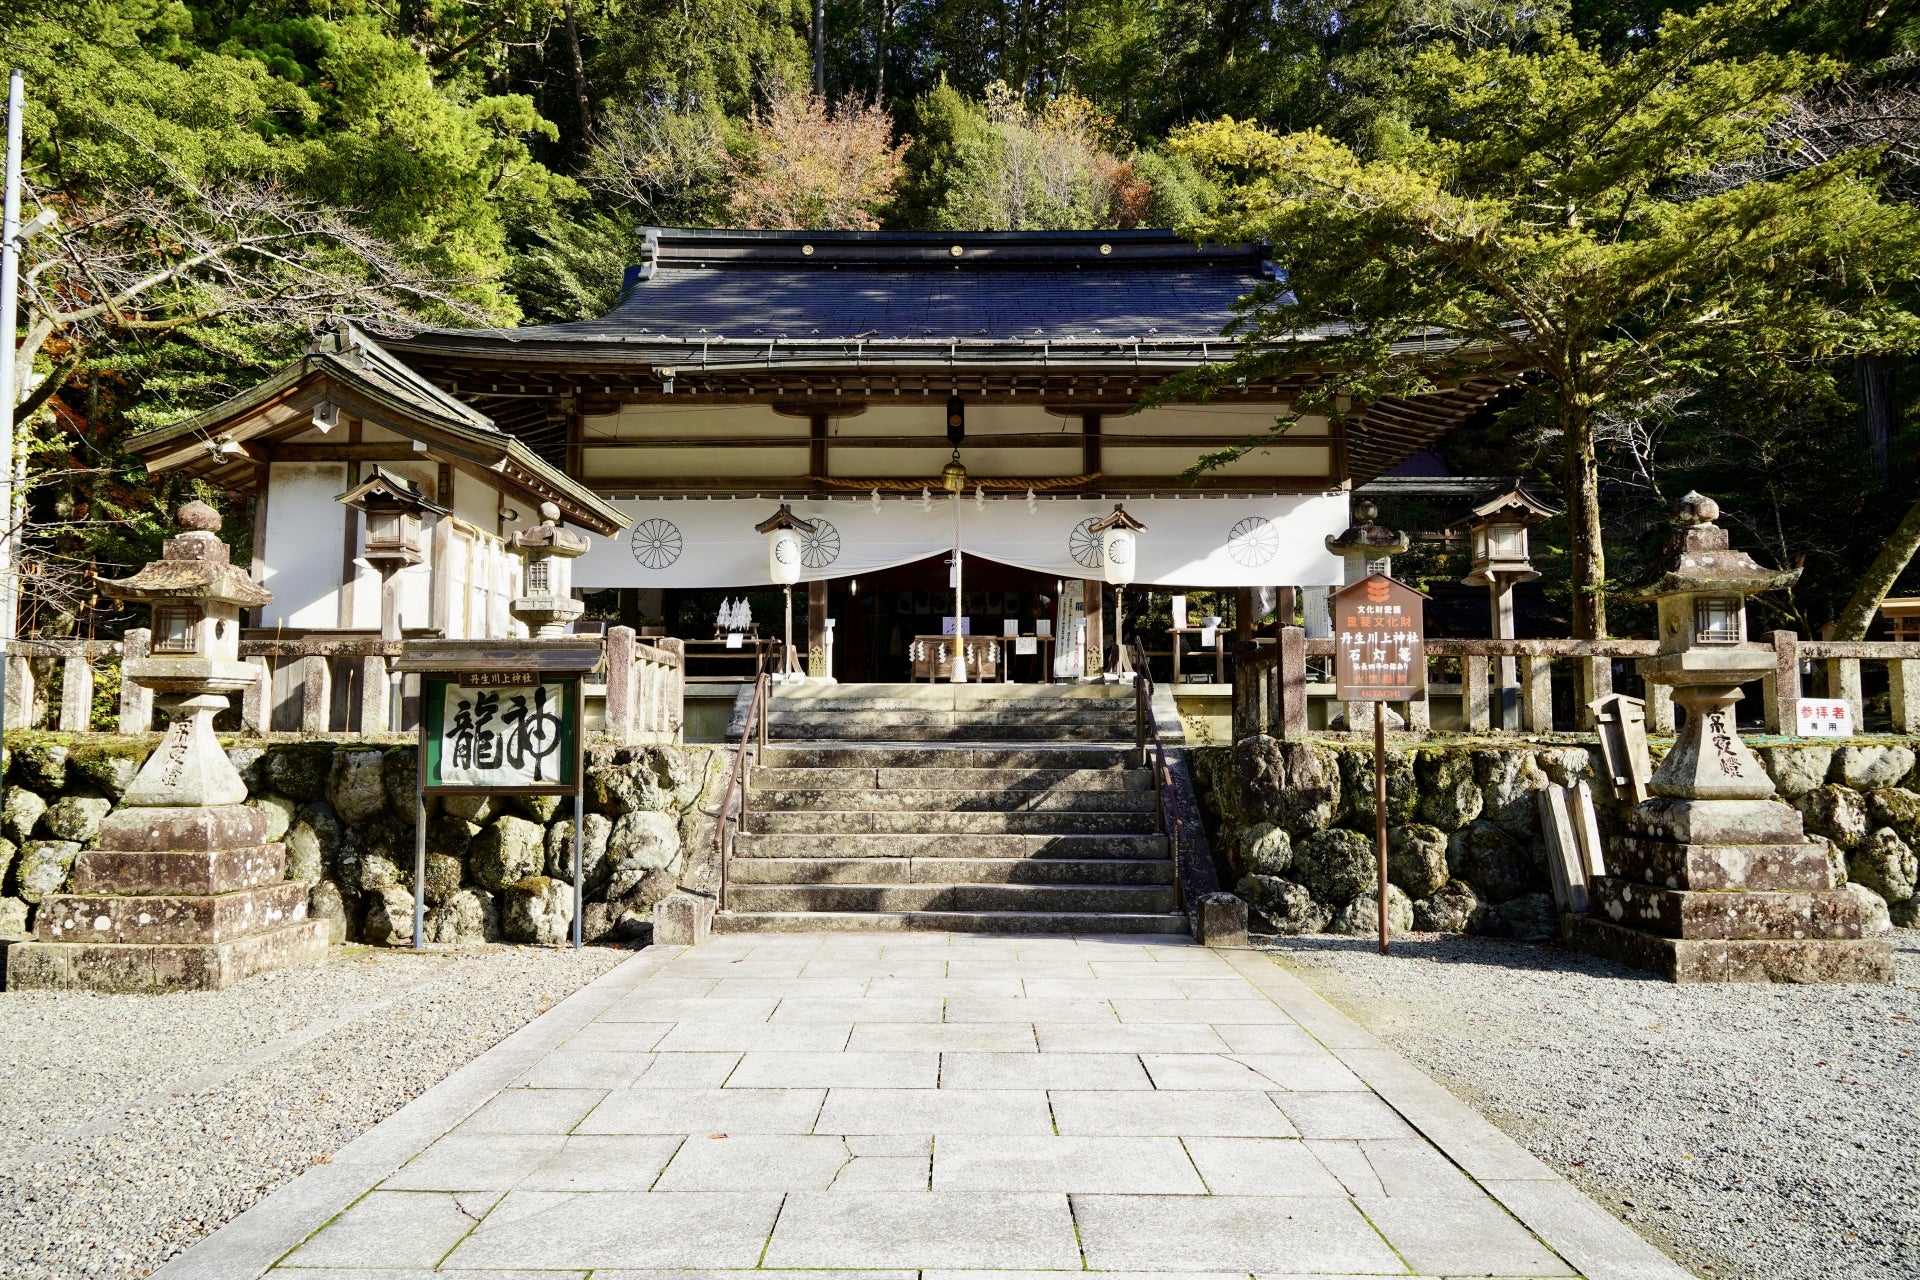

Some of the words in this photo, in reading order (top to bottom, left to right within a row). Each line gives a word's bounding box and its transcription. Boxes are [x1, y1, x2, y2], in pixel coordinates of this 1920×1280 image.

[1357, 605, 1402, 614] 文化財愛護
[1346, 616, 1412, 628] 重要文化財
[1340, 631, 1420, 645] 丹生川上神社
[470, 673, 532, 685] 丹生川上神社
[1801, 705, 1845, 720] 参拝者
[1811, 722, 1837, 732] 専用
[445, 686, 562, 782] 龍神
[1706, 703, 1744, 778] 常夜燈
